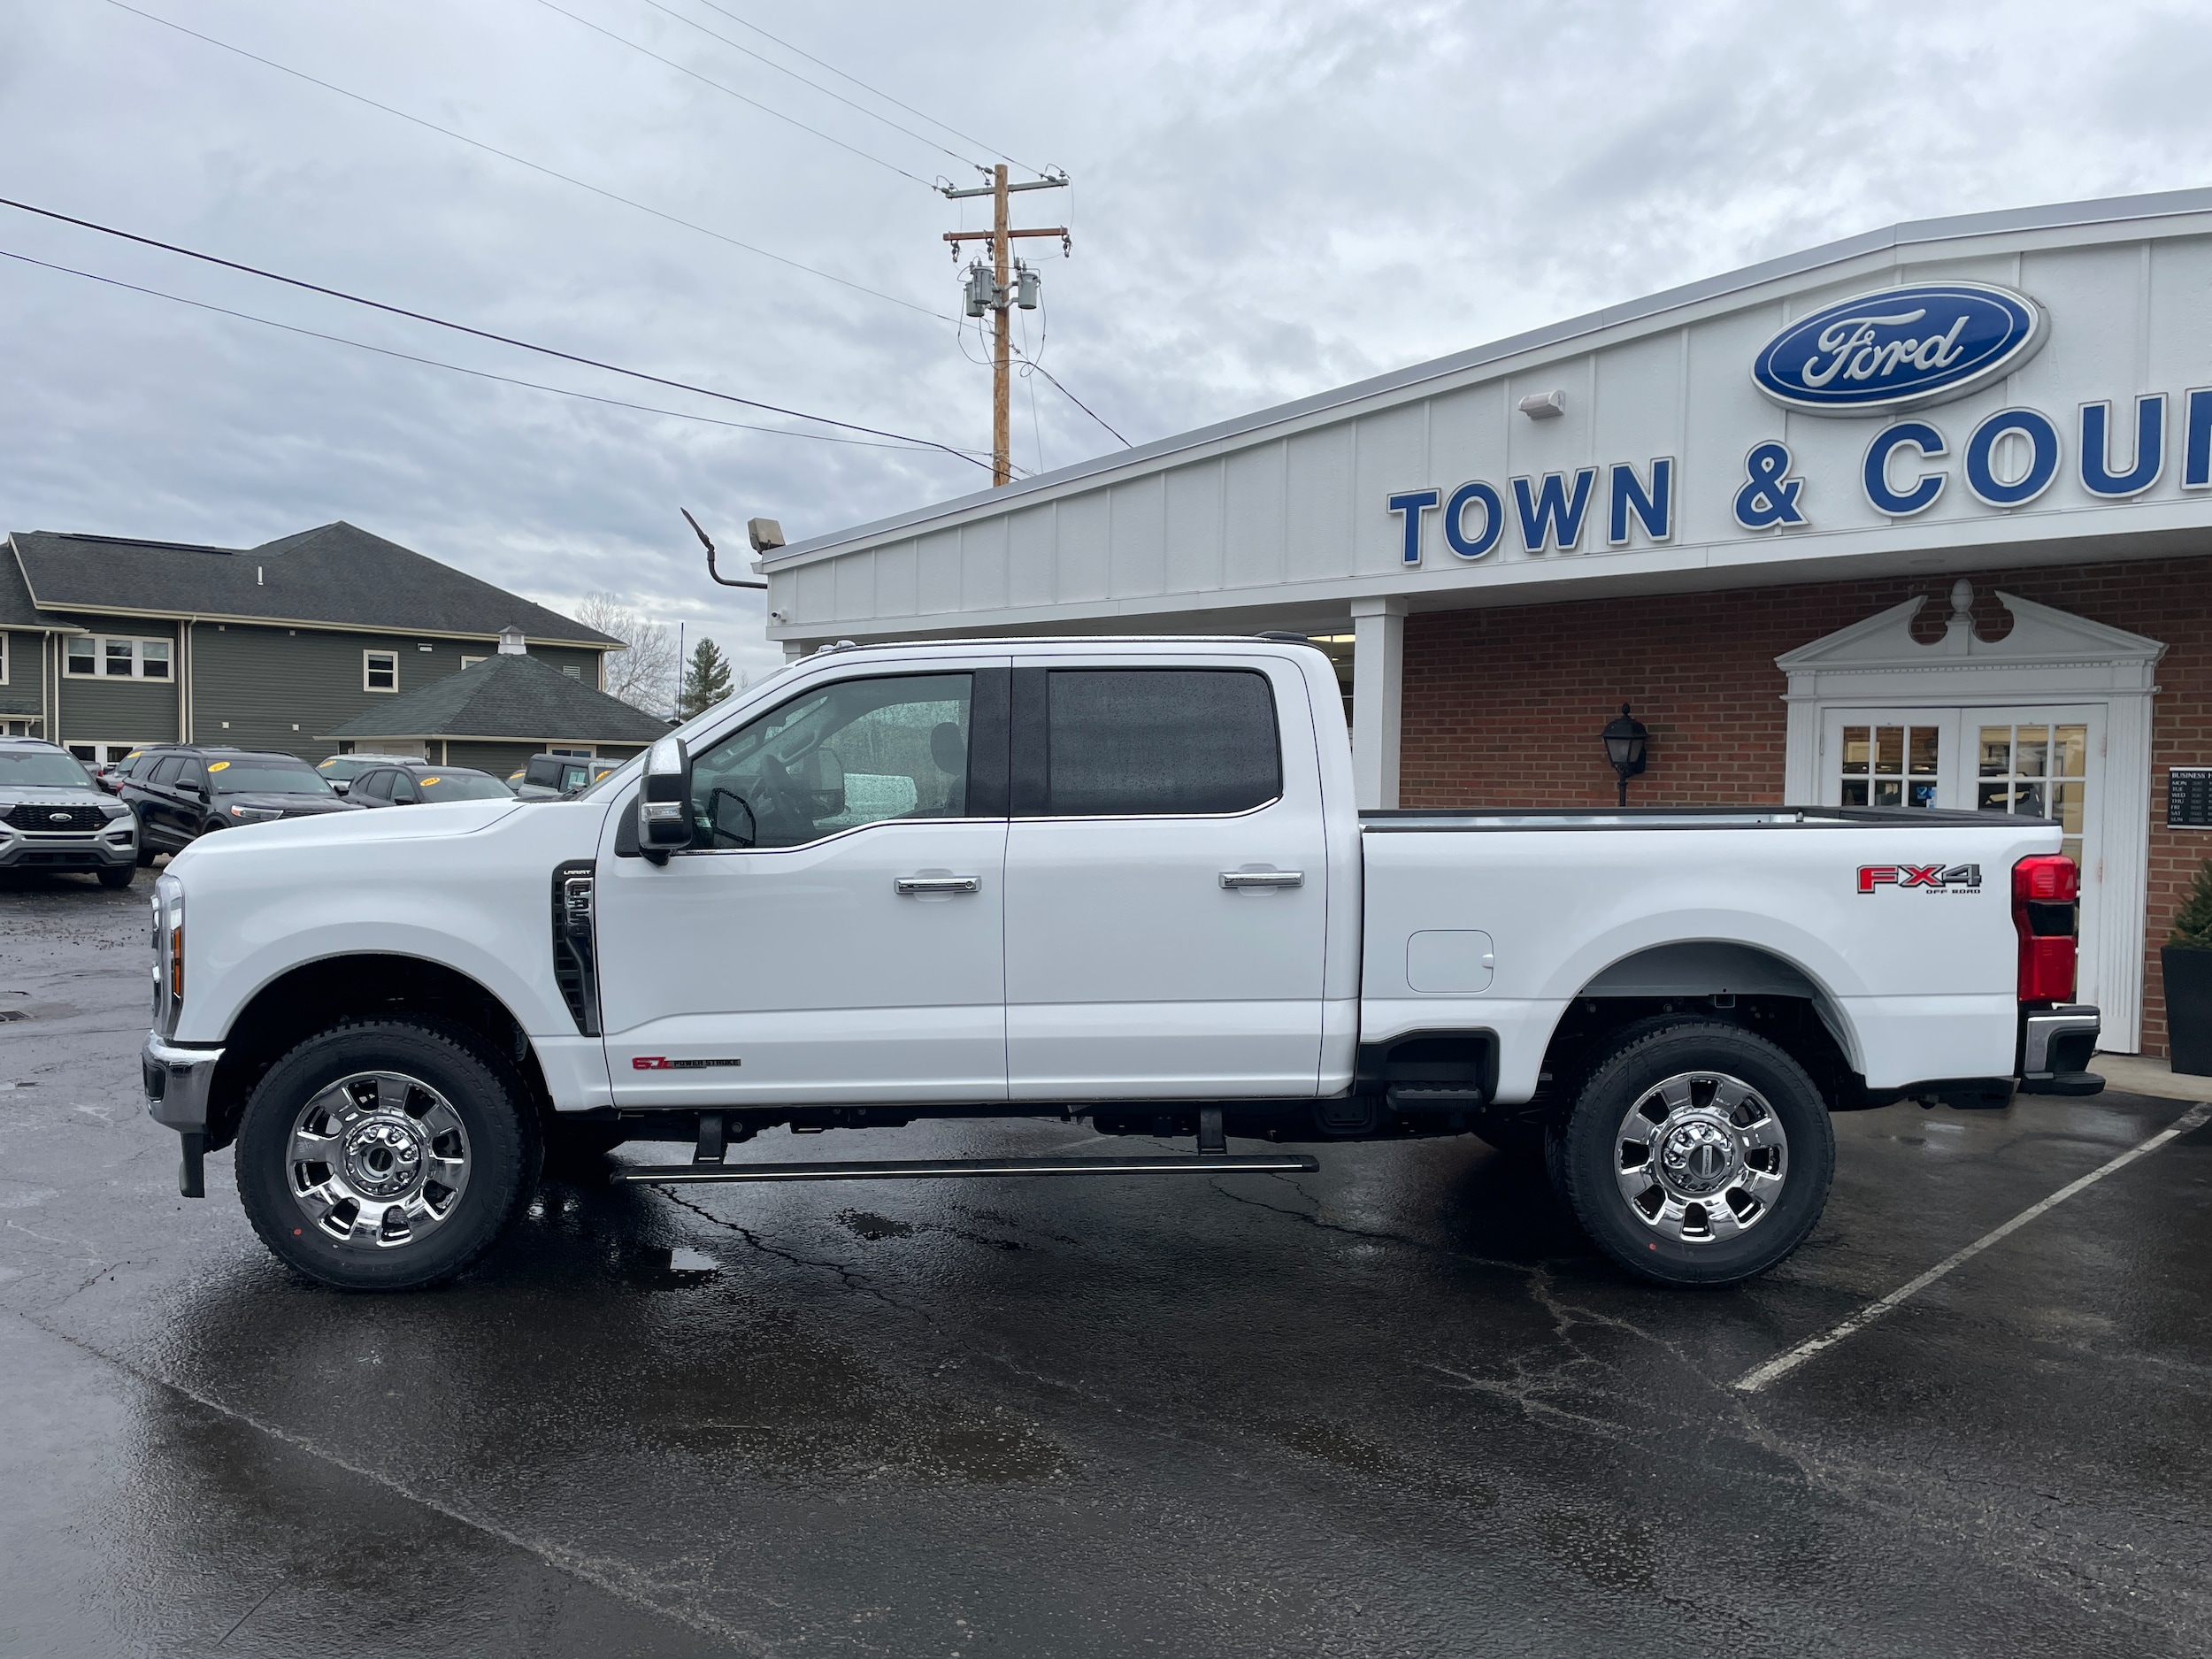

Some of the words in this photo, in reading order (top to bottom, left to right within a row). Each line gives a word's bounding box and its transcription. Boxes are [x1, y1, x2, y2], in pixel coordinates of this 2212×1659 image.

[1801, 308, 1970, 388] Ford
[1386, 456, 1675, 566] TOWN
[1732, 439, 1811, 532] &
[1857, 864, 1982, 894] FX4
